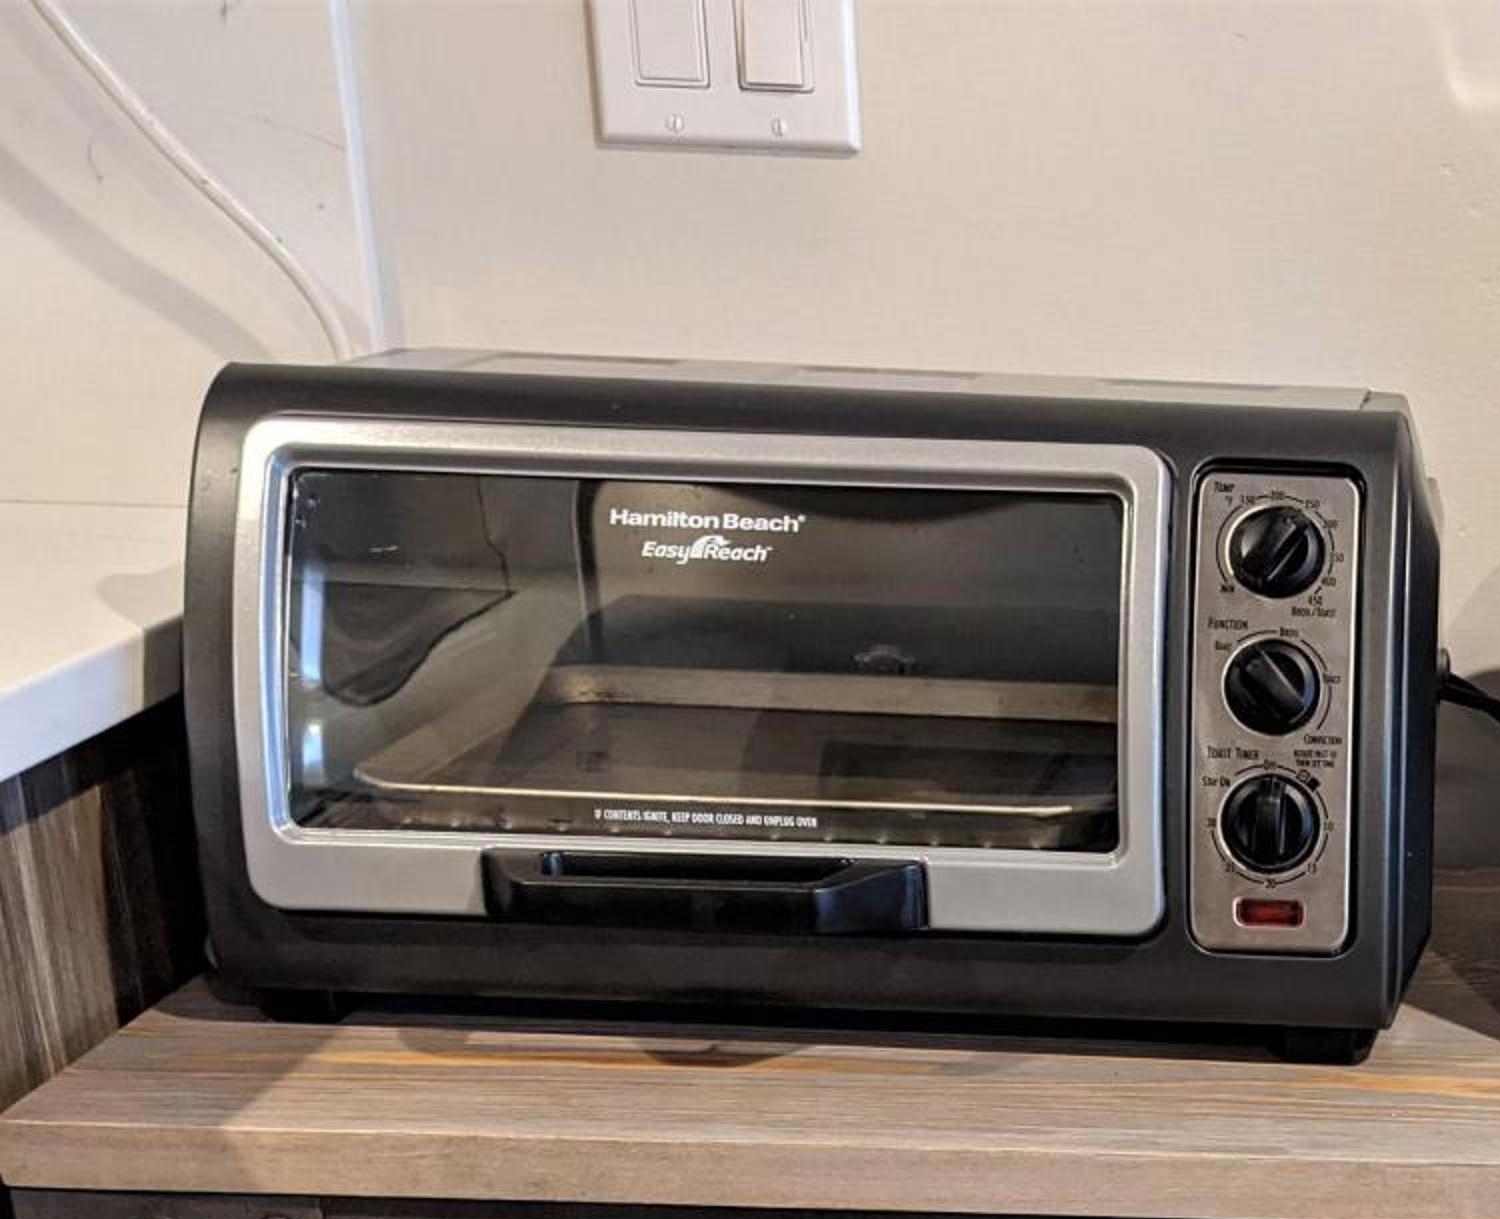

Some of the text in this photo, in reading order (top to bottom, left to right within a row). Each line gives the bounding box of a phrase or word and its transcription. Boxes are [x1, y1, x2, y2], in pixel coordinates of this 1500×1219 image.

[609, 508, 720, 530] Hamilton
[1207, 617, 1248, 632] FUNCTION
[671, 812, 690, 823] KEEP
[691, 813, 714, 825] DOOR
[715, 813, 744, 825] CLOSED
[746, 815, 762, 825] AND
[796, 816, 817, 827] OVEN
